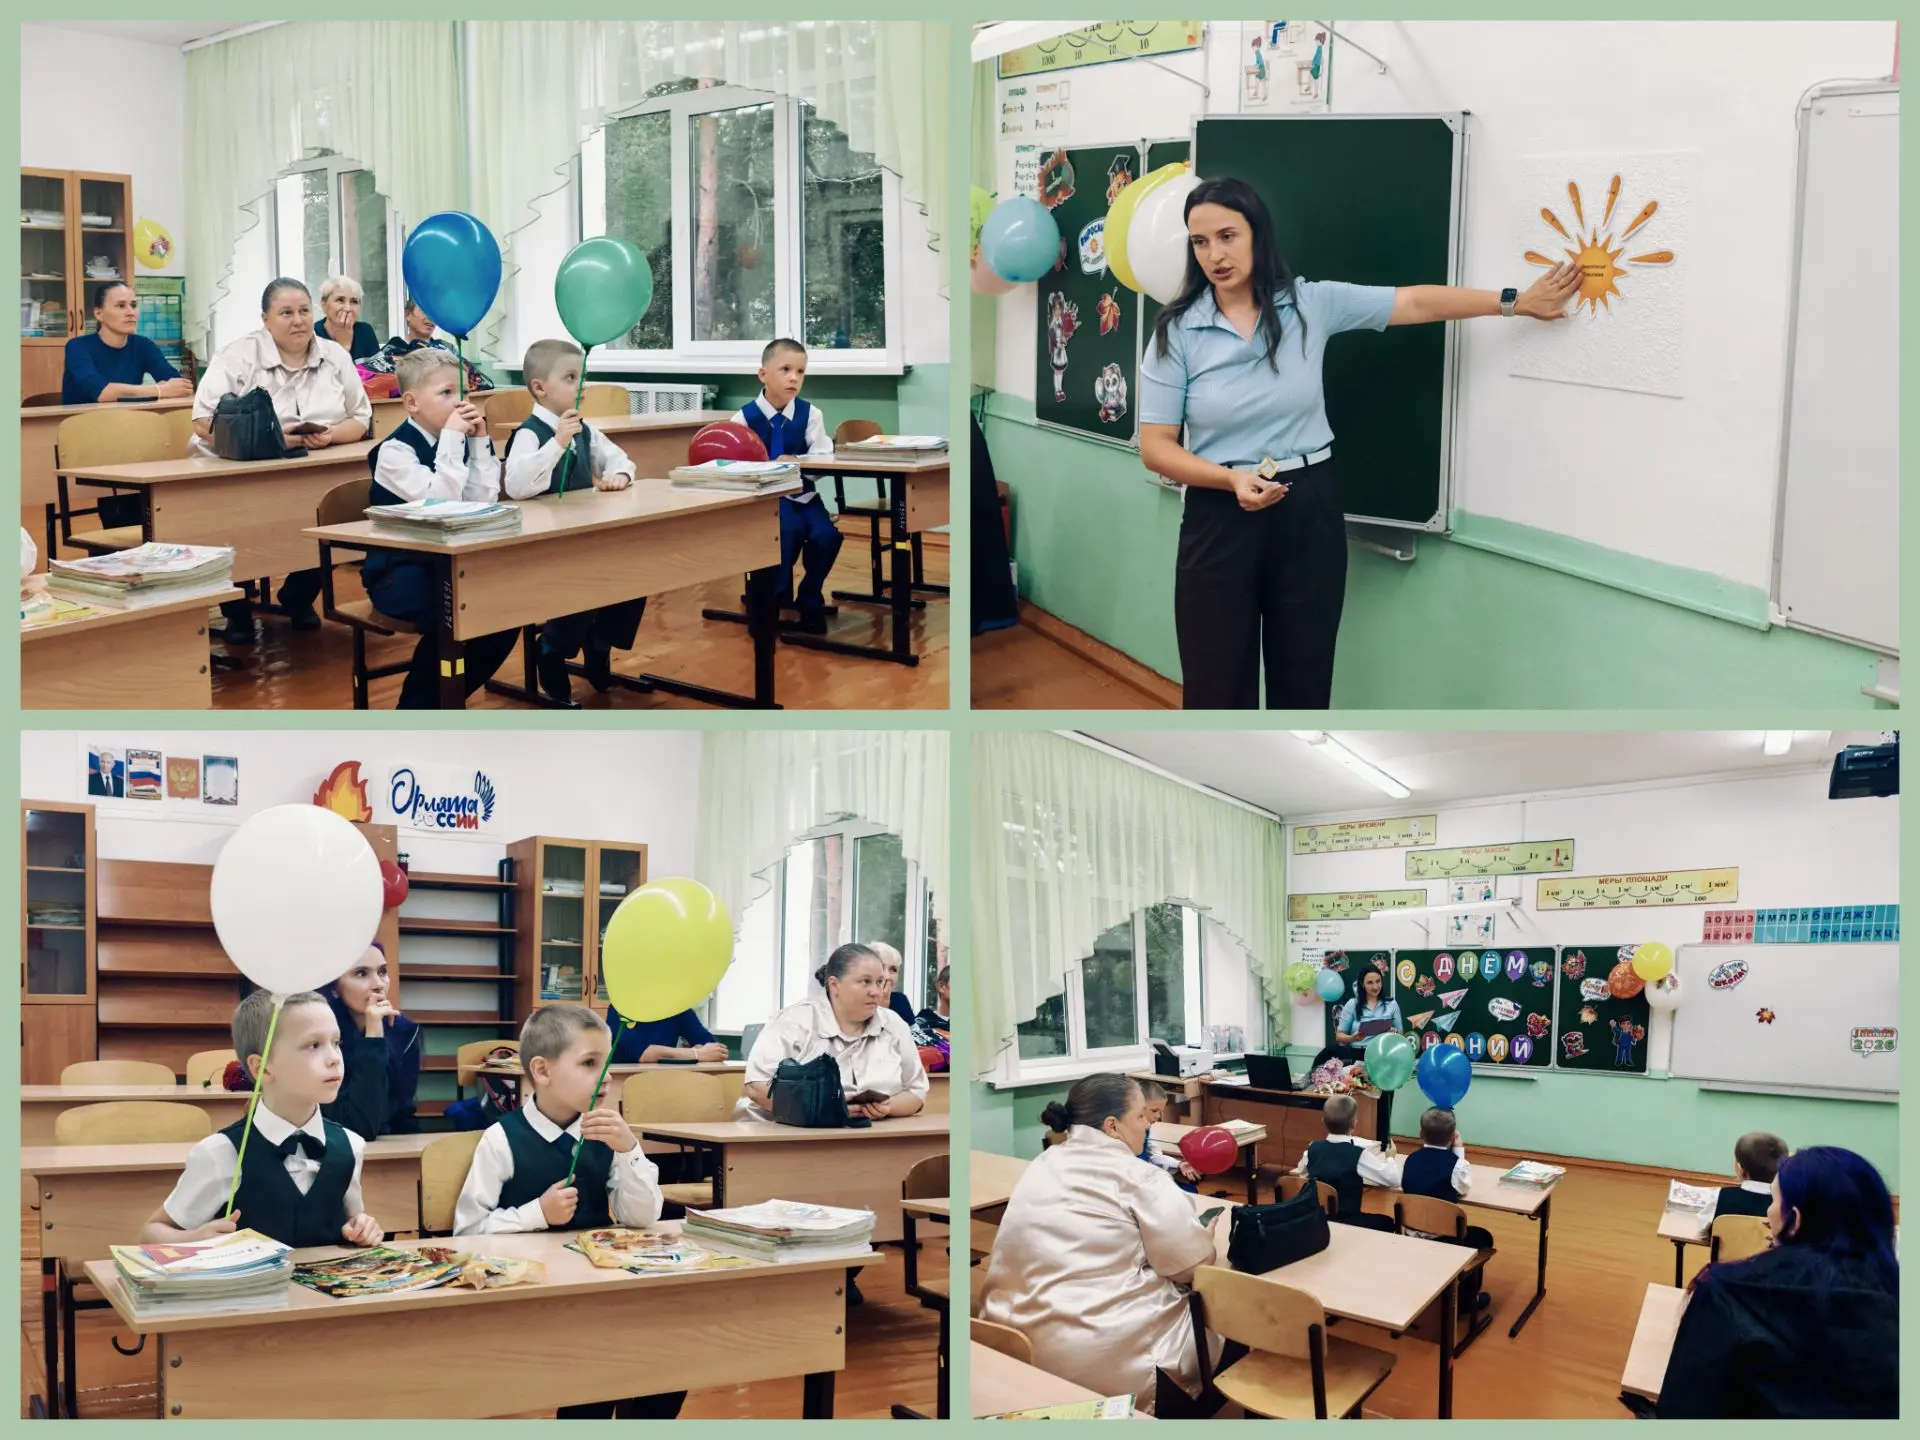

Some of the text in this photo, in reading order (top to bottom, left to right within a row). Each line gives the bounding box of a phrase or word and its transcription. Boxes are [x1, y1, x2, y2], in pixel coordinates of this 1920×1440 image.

[1041, 54, 1056, 66] 1000
[1074, 49, 1082, 61] 10
[1140, 38, 1149, 50] 10
[391, 768, 479, 820] Орлята
[412, 811, 479, 830] РОССИИ
[1626, 875, 1668, 883] ПЛОЩАДИ
[1401, 953, 1525, 981] С ДНЁМ
